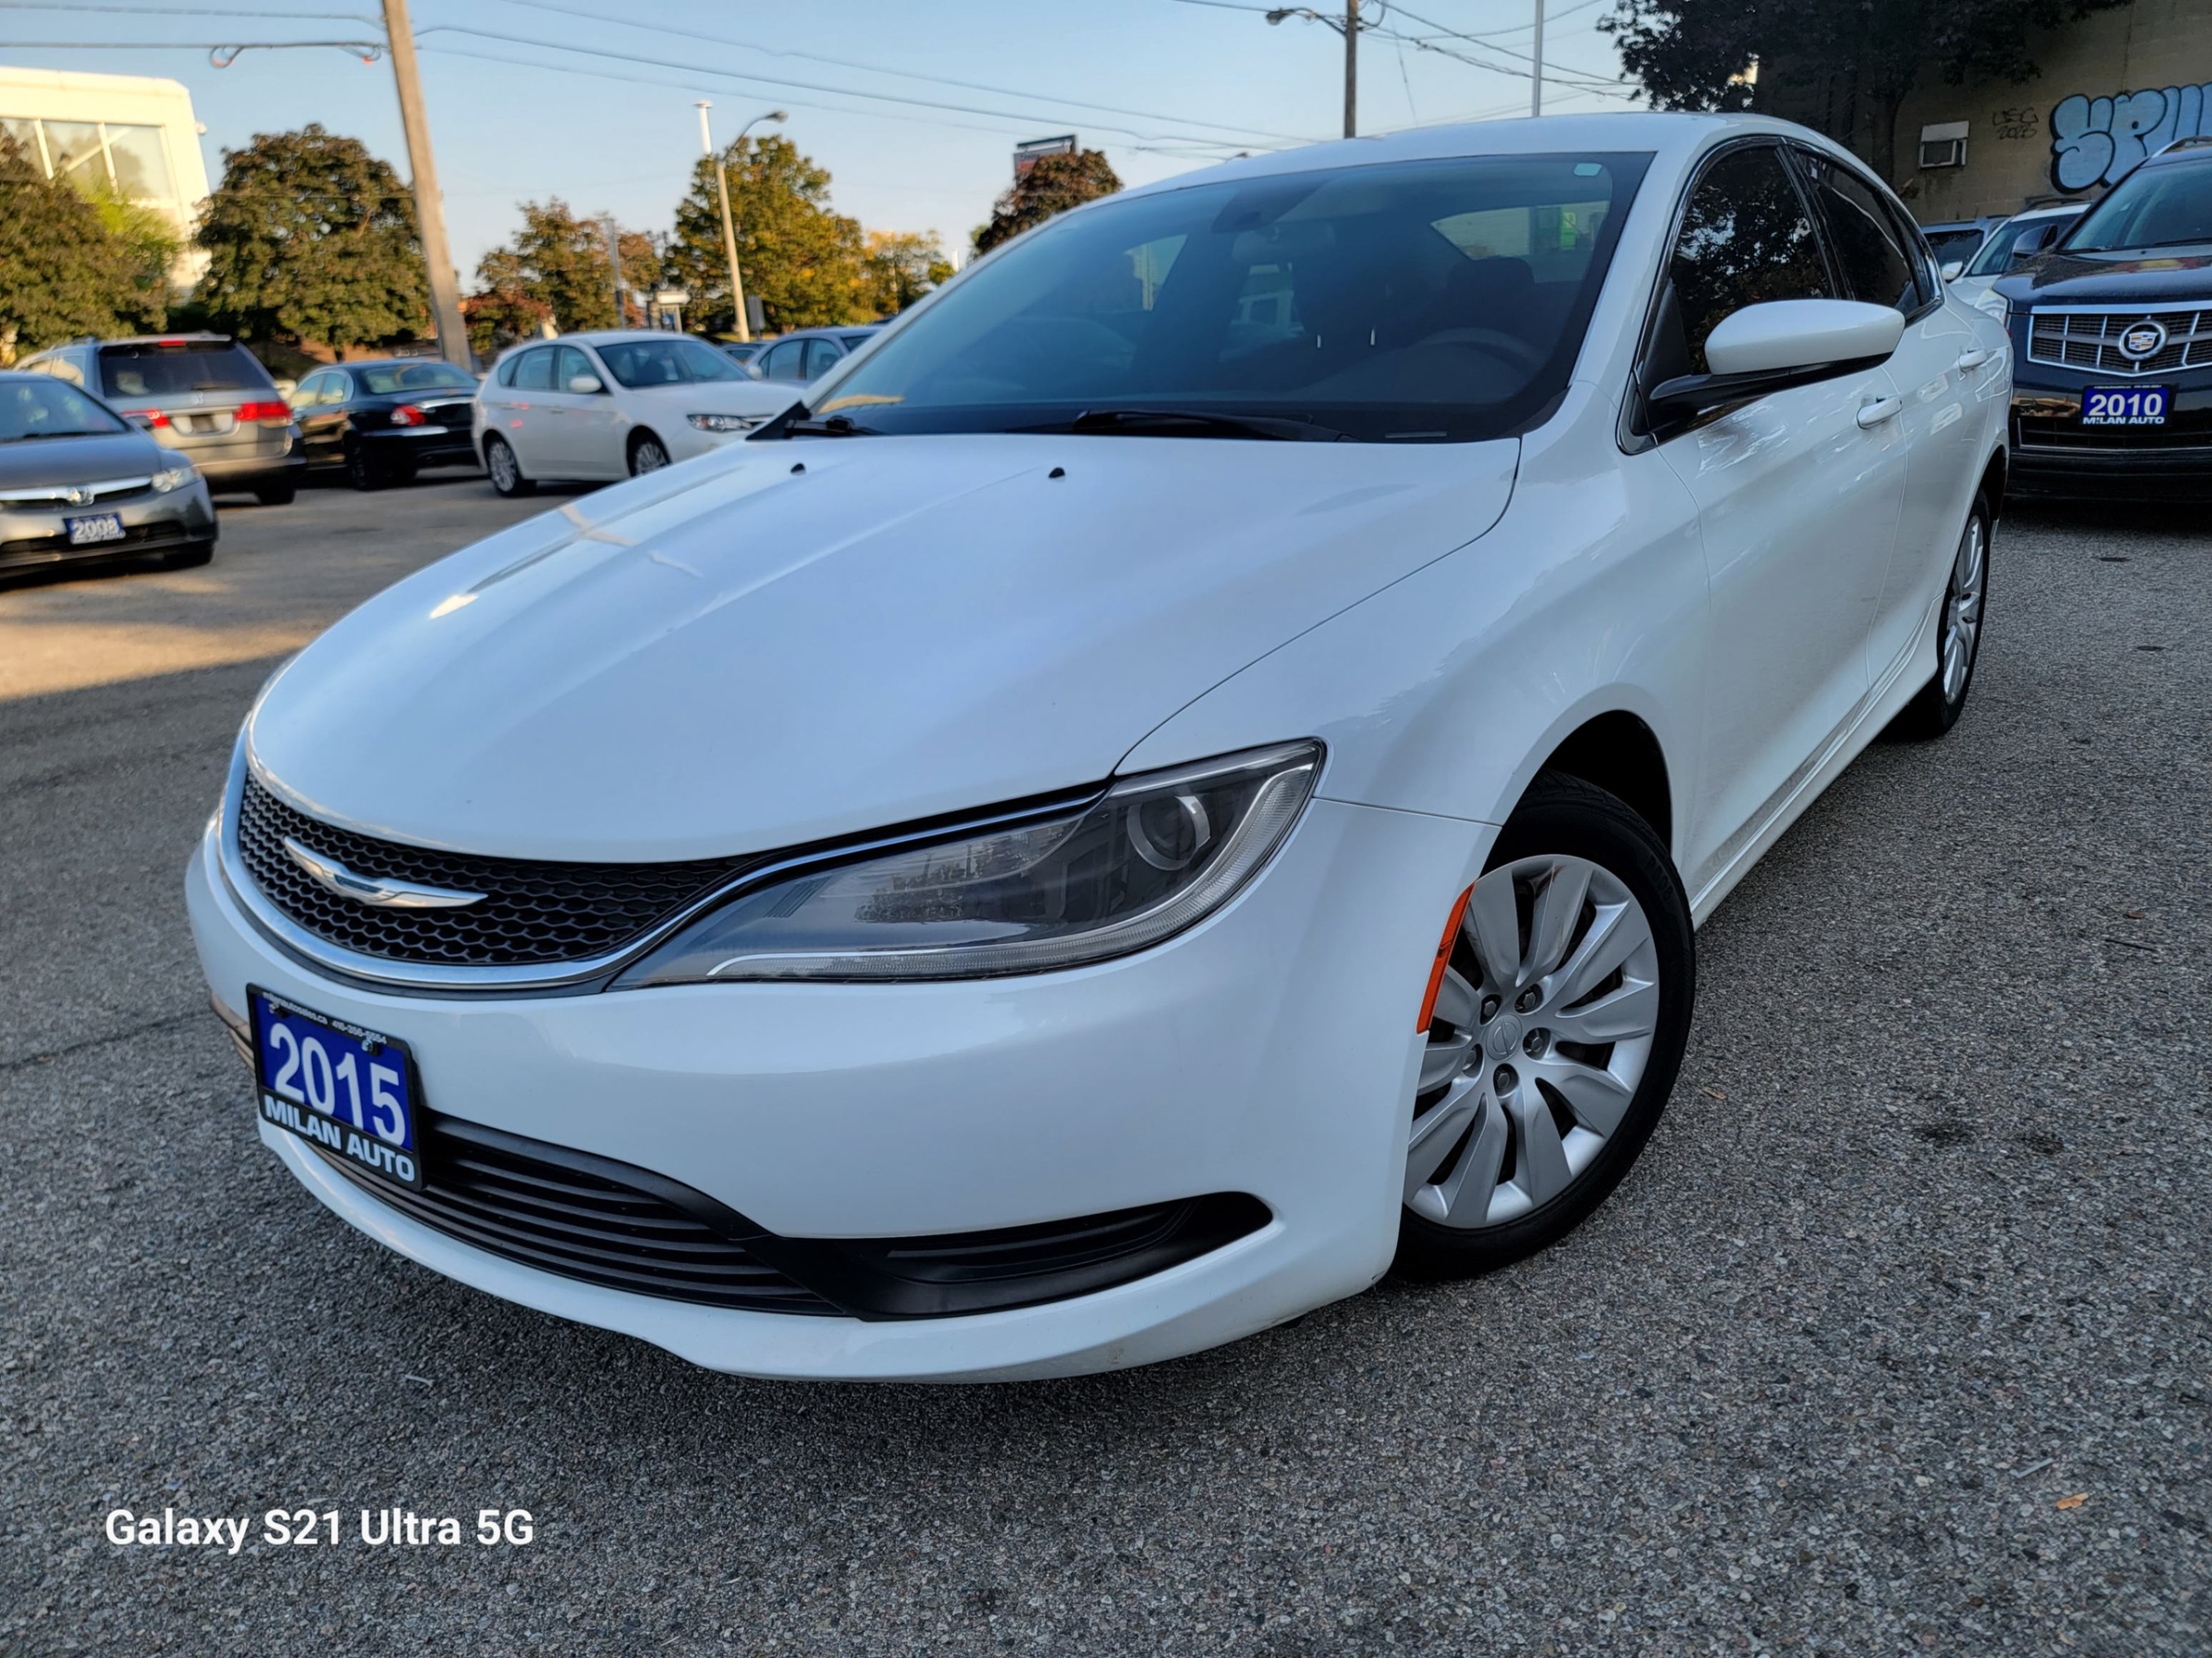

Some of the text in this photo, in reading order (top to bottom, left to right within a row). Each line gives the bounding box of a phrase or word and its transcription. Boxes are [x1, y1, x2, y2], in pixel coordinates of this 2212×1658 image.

[2083, 416, 2166, 425] MILAN AUTO
[2088, 393, 2163, 416] 2010
[269, 1022, 406, 1147] 2015
[264, 1094, 415, 1183] MILAN AUTO
